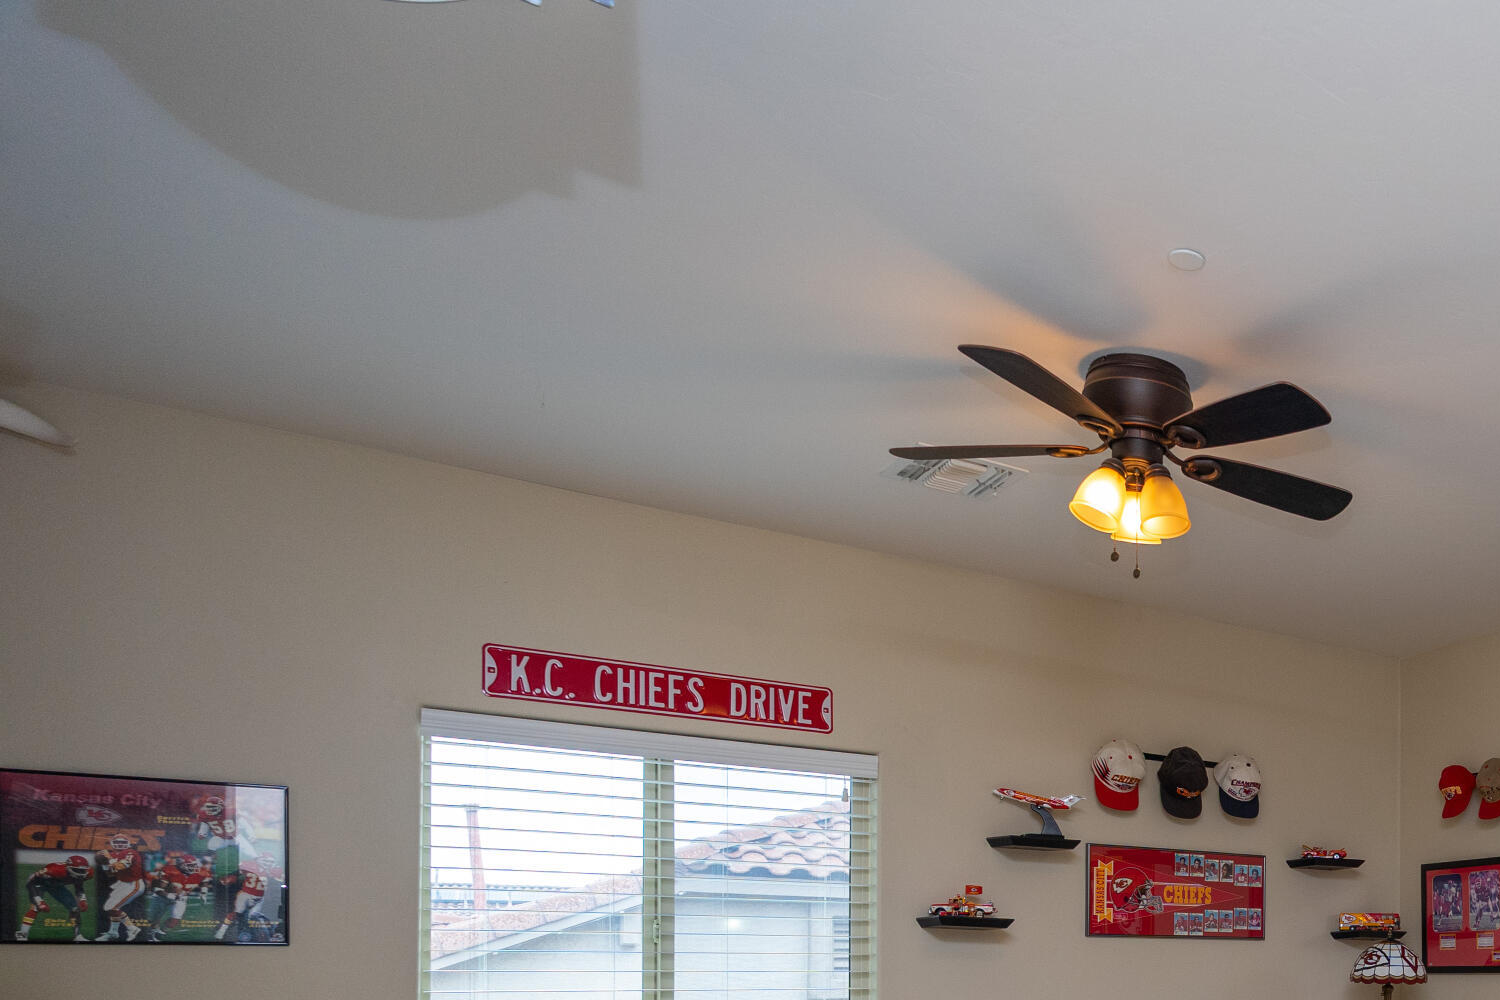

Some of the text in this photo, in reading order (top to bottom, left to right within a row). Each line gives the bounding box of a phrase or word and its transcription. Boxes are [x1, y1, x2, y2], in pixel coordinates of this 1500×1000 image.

[510, 654, 813, 725] K.C. CHIEFS DRIVE
[120, 793, 161, 809] City
[1163, 885, 1212, 905] CHIEFS
